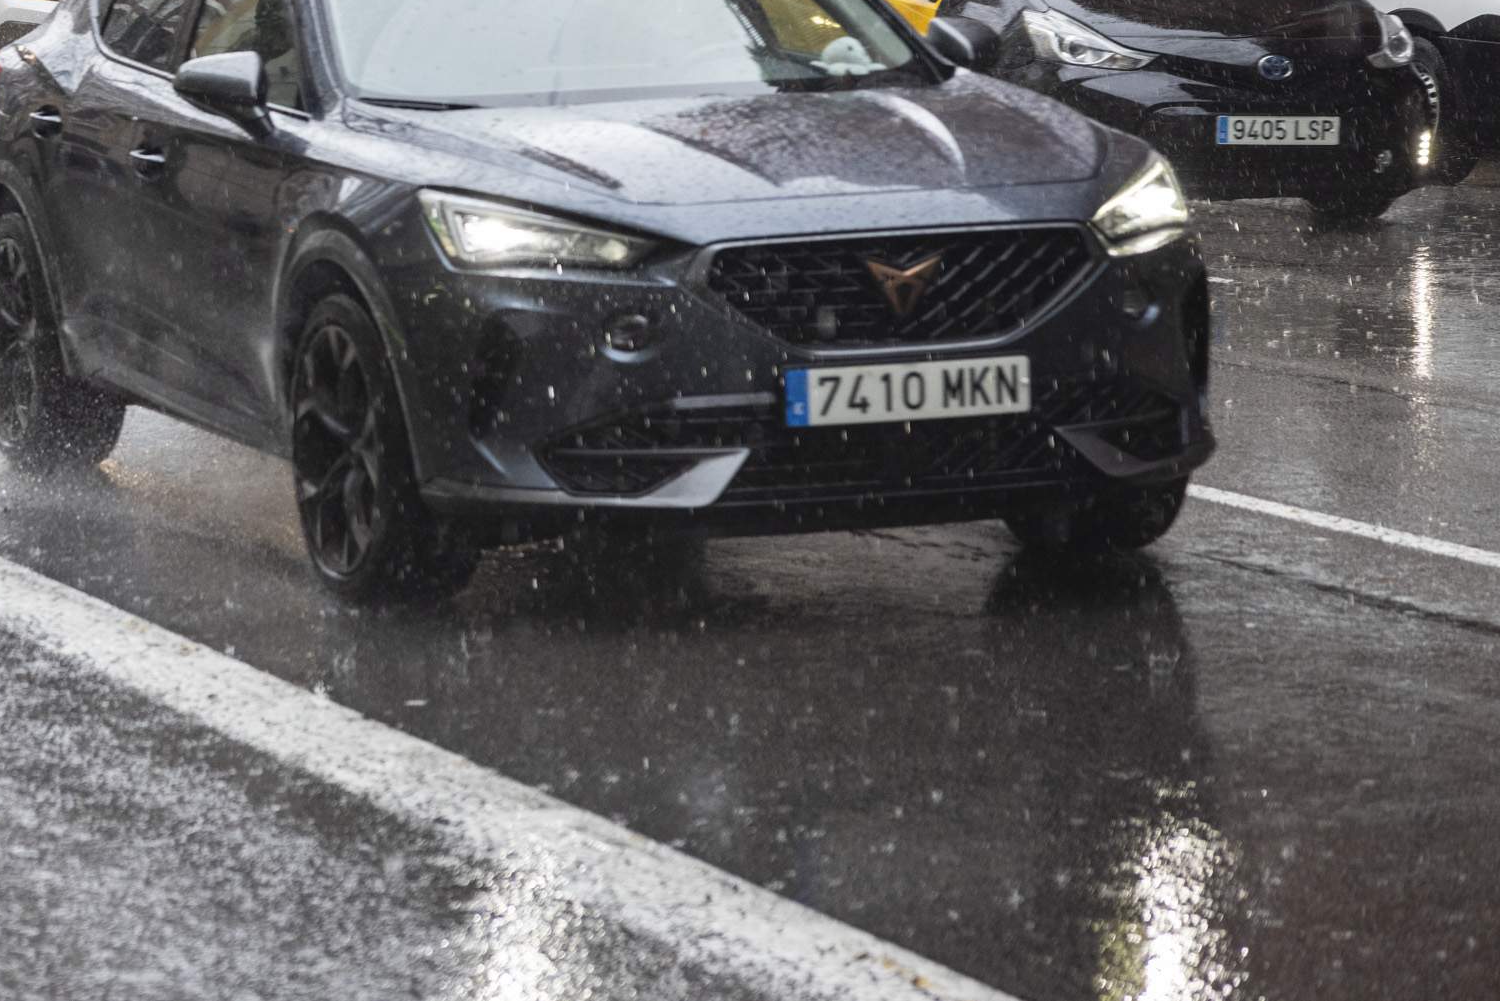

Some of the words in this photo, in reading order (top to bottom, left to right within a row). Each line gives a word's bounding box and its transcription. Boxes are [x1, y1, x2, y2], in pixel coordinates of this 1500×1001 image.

[1233, 120, 1287, 140] 9405
[1294, 120, 1334, 140] LSP
[818, 371, 925, 416] 7410
[942, 364, 1019, 408] MKN
